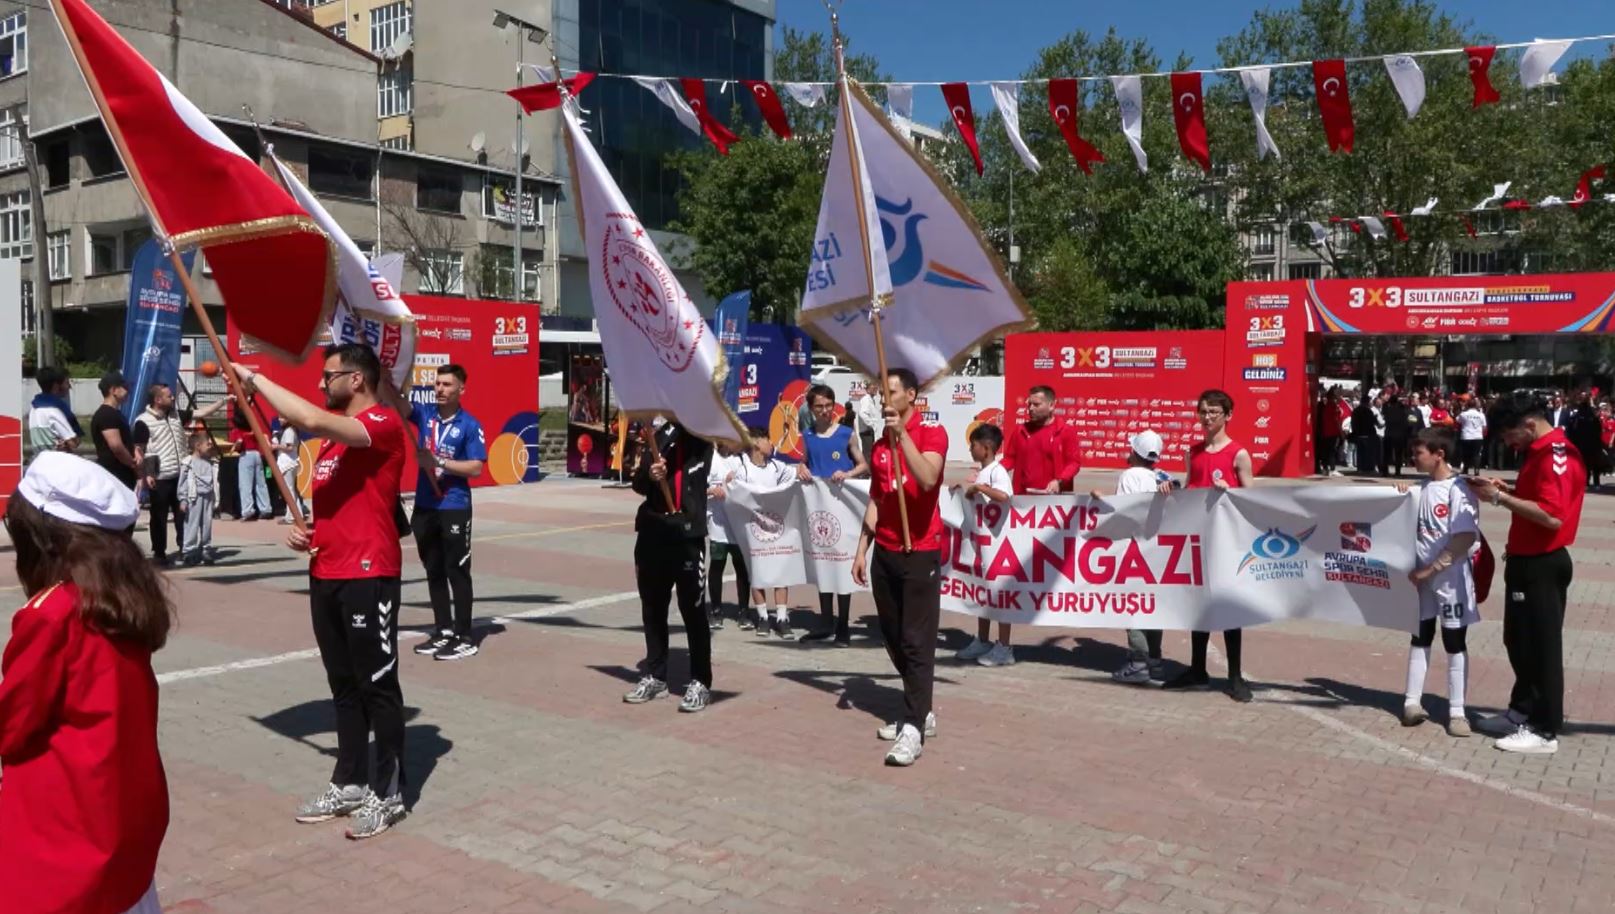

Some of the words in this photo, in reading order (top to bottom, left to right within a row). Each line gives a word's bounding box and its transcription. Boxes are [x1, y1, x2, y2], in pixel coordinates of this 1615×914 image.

[1348, 286, 1401, 308] 3X3
[1408, 291, 1480, 303] SULTANGAZİ
[495, 317, 527, 334] 3X3
[1060, 346, 1110, 369] 3X3
[1244, 367, 1284, 379] GELDİNİZ
[976, 503, 1002, 529] 19
[1010, 504, 1099, 530] MAYIS
[1250, 559, 1308, 573] SULTANGAZİ
[1324, 551, 1366, 566] AVRUPA
[940, 576, 1023, 611] GENÇLİK
[1026, 590, 1156, 616] YÜRÜYÜŞÜ
[1442, 603, 1464, 619] 20
